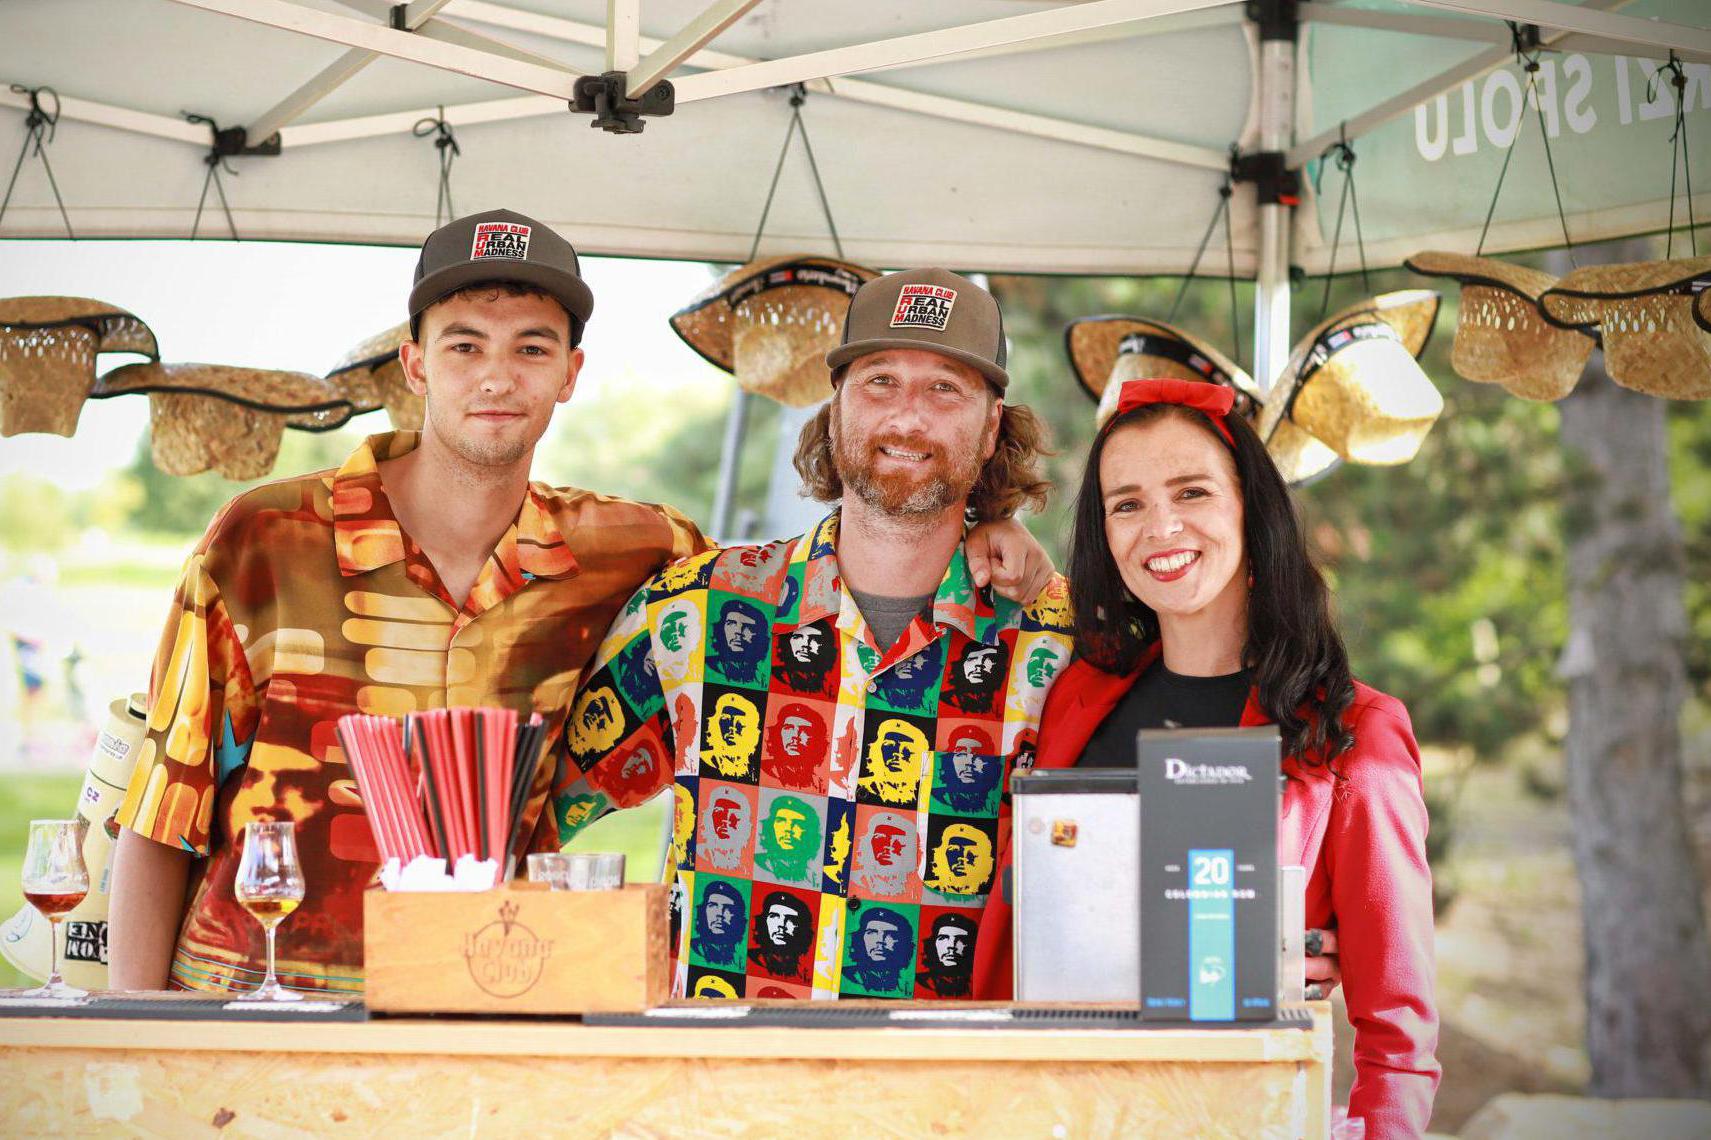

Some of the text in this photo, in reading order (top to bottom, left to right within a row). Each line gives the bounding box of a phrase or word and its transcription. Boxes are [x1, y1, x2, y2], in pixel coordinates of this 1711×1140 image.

[511, 226, 528, 235] CLUB
[477, 233, 527, 243] REAL
[475, 240, 527, 251] URBAN
[474, 249, 524, 257] MADNESS
[904, 286, 954, 299] HAVANA CLUB
[900, 296, 950, 310] REAL
[897, 306, 949, 318] URBAN
[894, 314, 946, 326] MADNESS
[1194, 856, 1230, 885] 20
